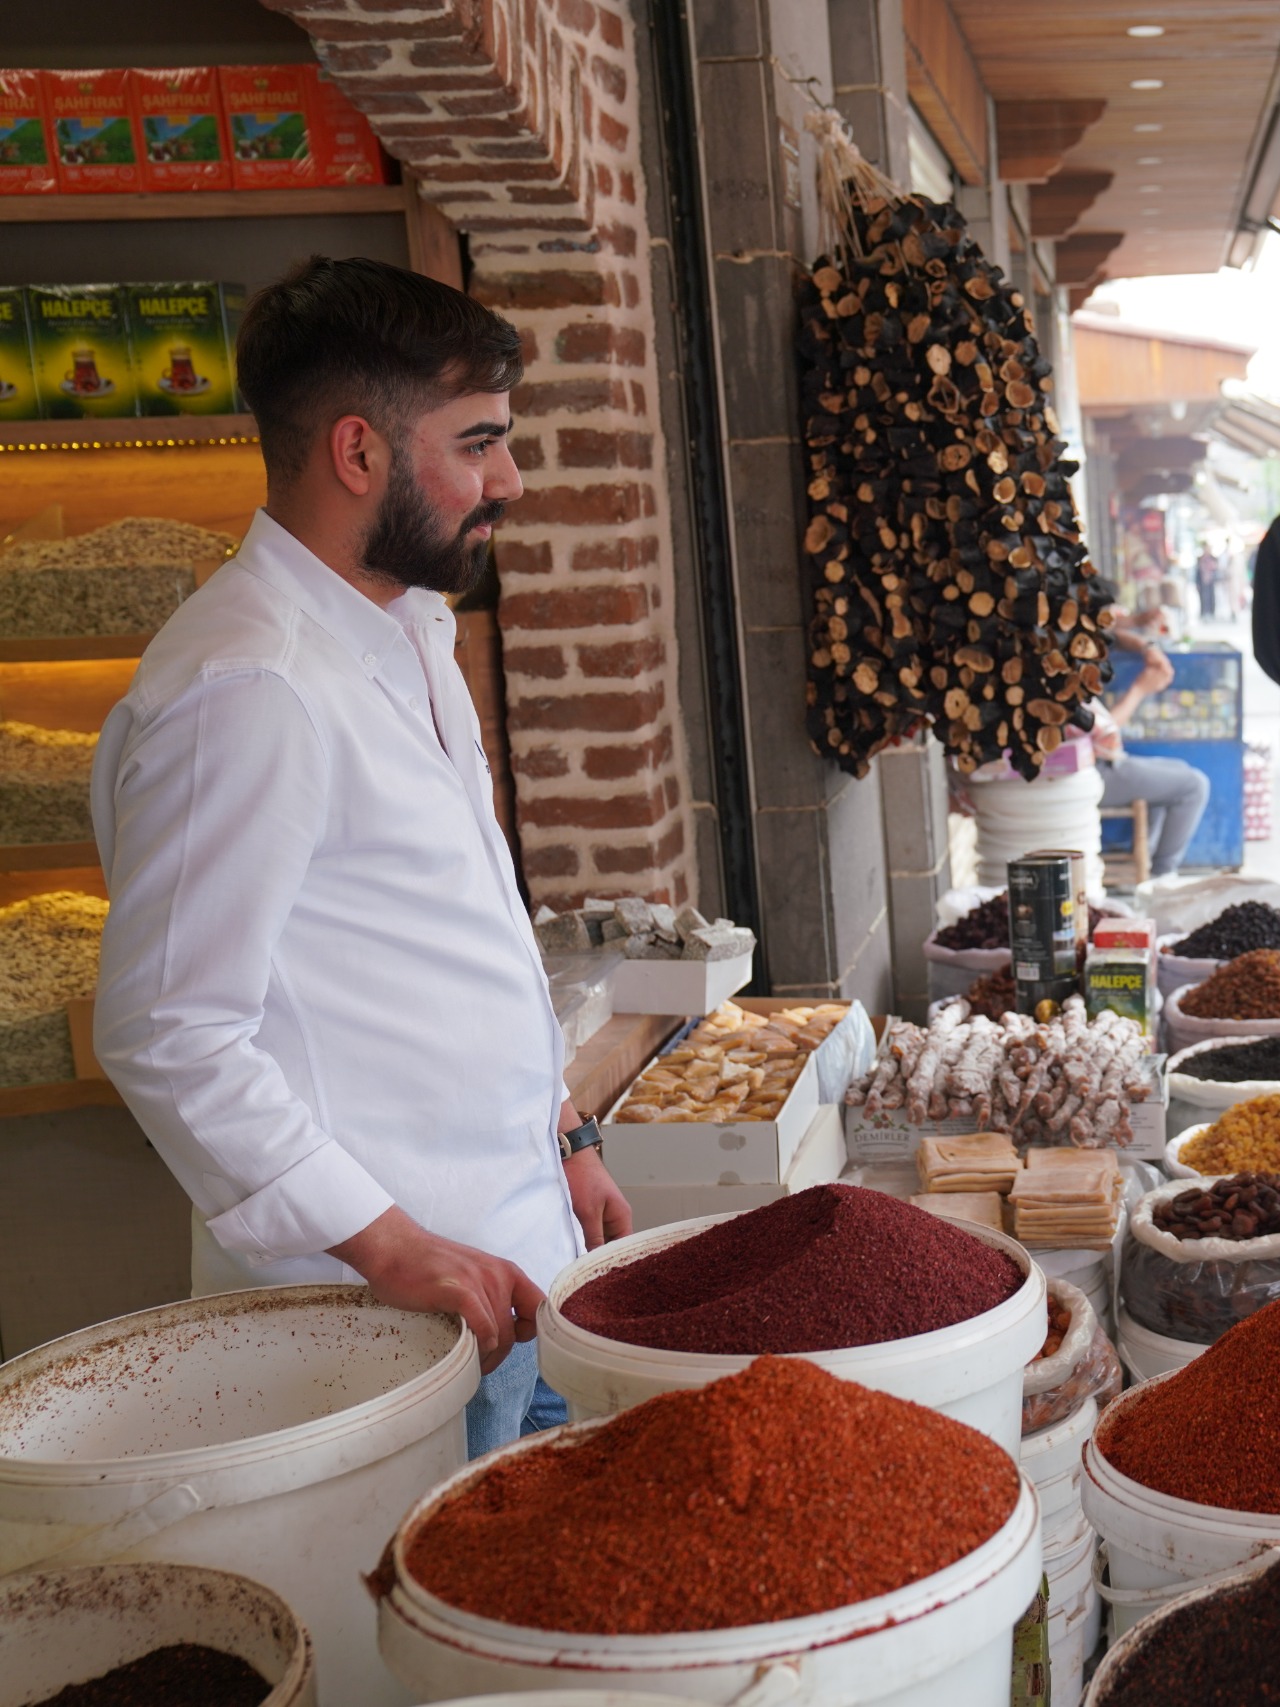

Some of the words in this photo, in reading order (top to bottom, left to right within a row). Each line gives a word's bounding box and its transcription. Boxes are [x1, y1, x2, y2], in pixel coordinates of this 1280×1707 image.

[41, 299, 112, 318] HALEPÇE
[139, 297, 208, 316] HALEPÇE
[1090, 974, 1143, 990] HALEPÇE
